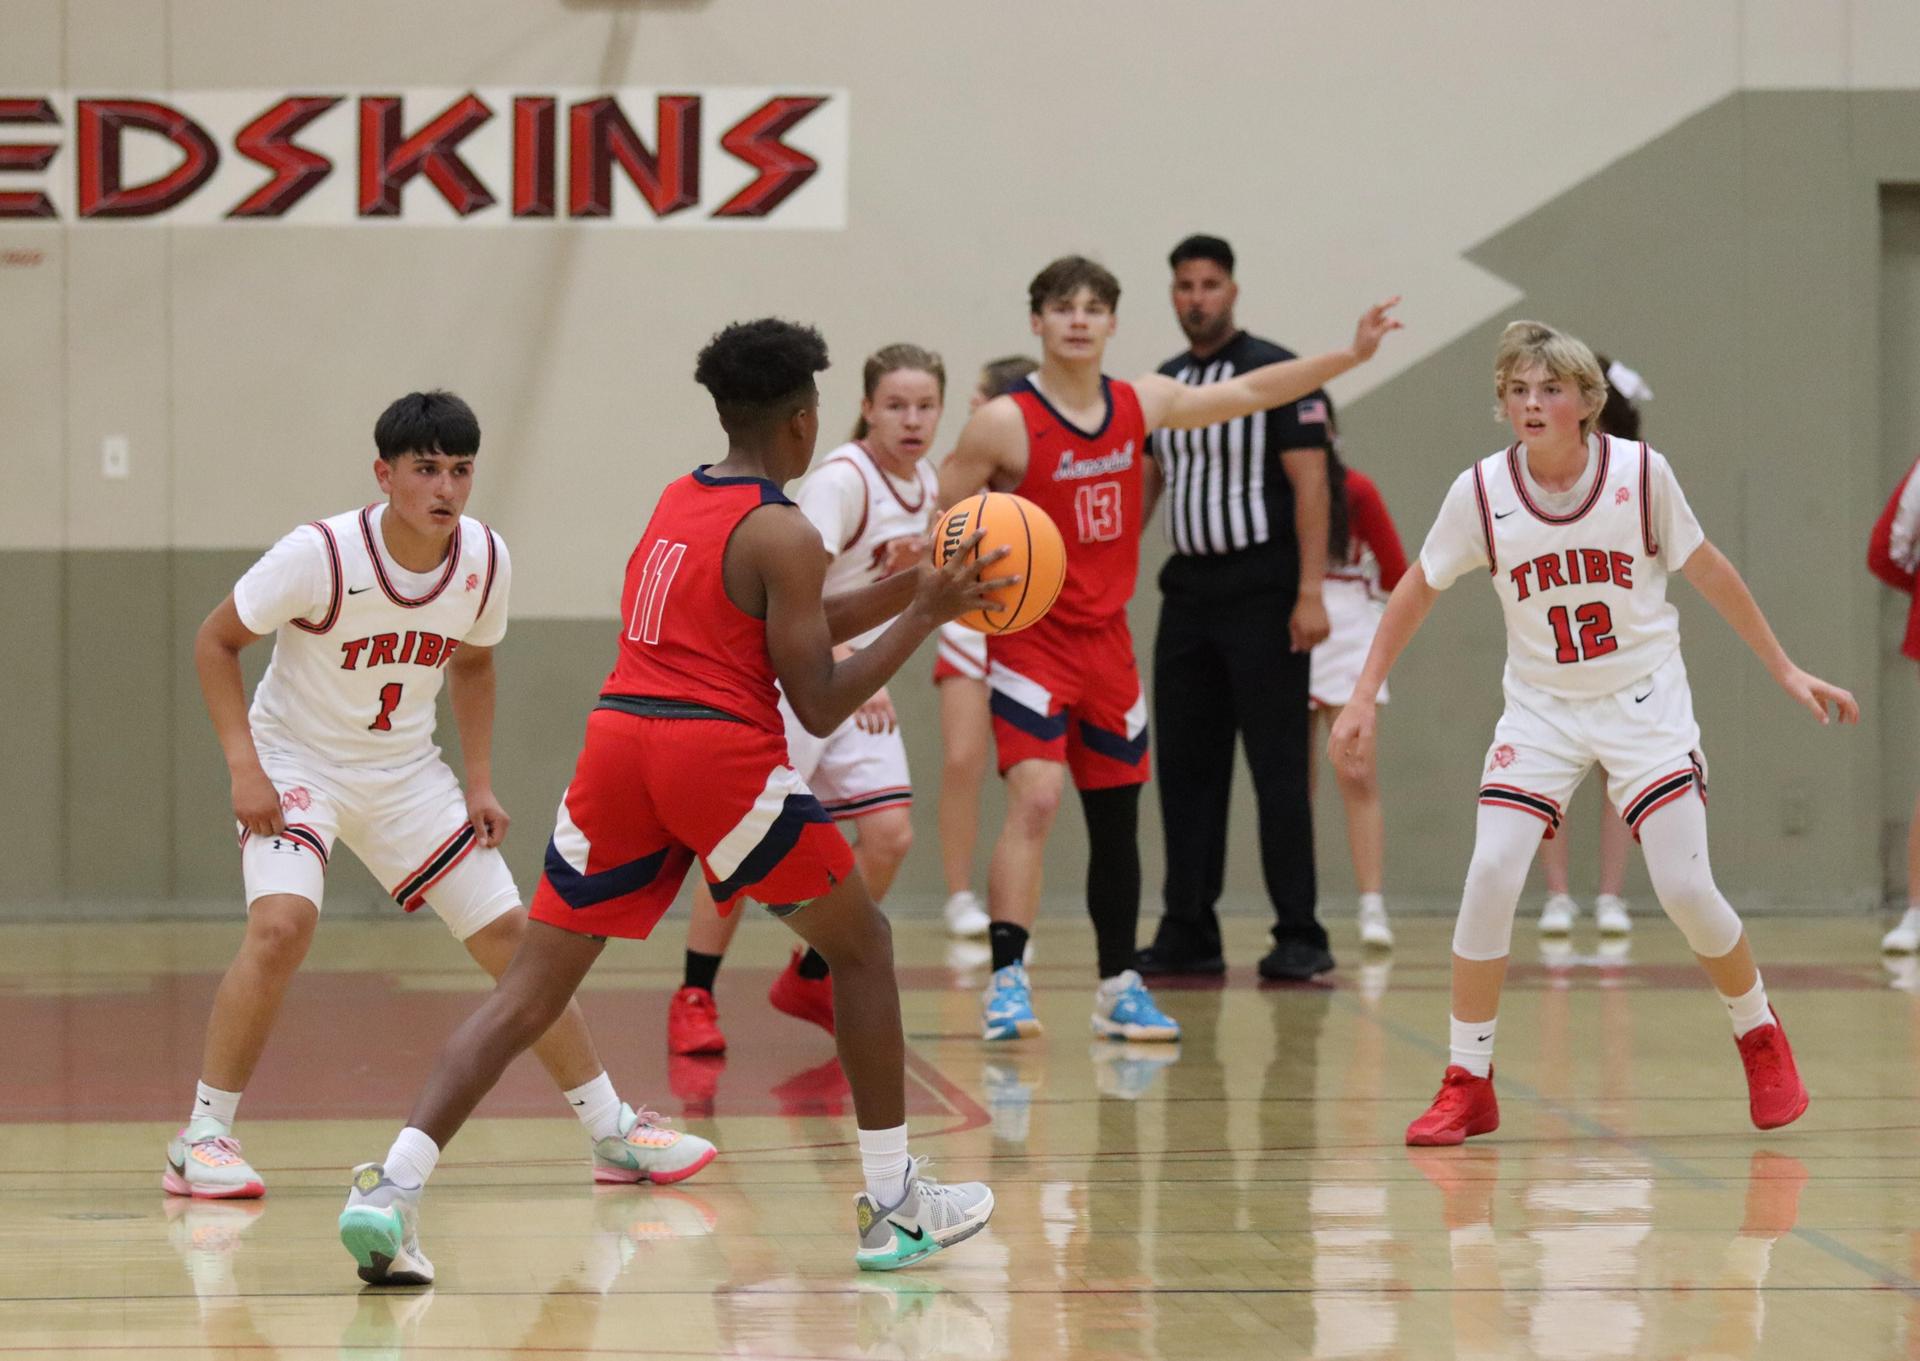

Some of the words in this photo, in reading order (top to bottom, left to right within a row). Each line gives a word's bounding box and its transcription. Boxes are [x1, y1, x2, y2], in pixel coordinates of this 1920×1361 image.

[0, 92, 833, 220] EDSKINS
[943, 511, 970, 566] Wil
[1074, 481, 1123, 543] 13
[628, 539, 688, 645] 11
[1510, 548, 1634, 602] TRIBE
[1547, 601, 1618, 664] 12
[368, 682, 403, 731] 1
